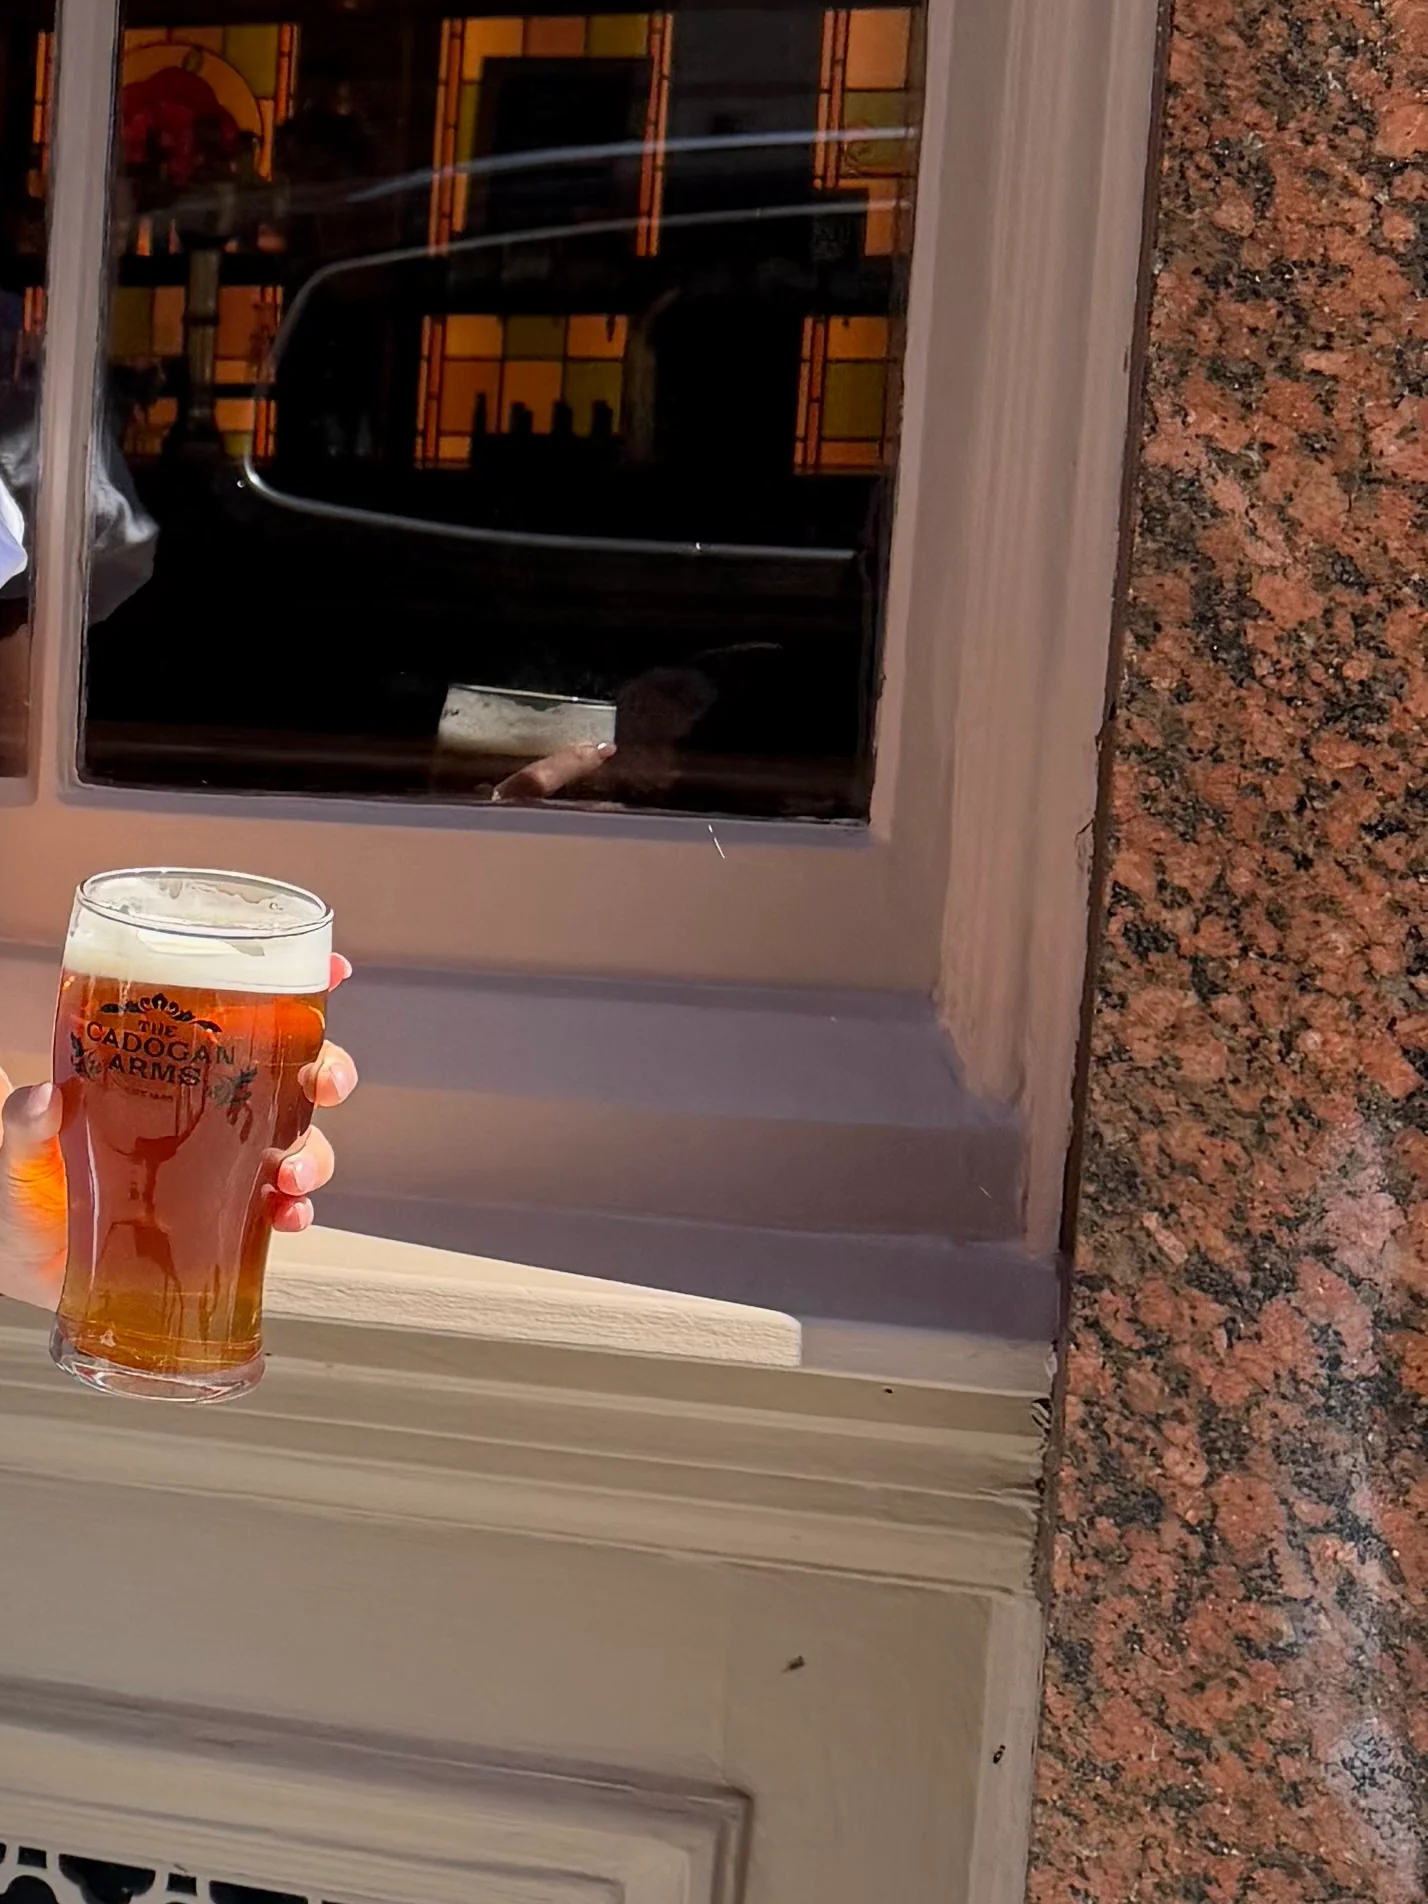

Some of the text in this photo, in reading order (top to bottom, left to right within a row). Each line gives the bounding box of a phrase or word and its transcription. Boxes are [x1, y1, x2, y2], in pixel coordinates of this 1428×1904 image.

[87, 1021, 235, 1064] CADOGAN
[138, 1020, 178, 1037] THE
[108, 1054, 201, 1086] ARMS
